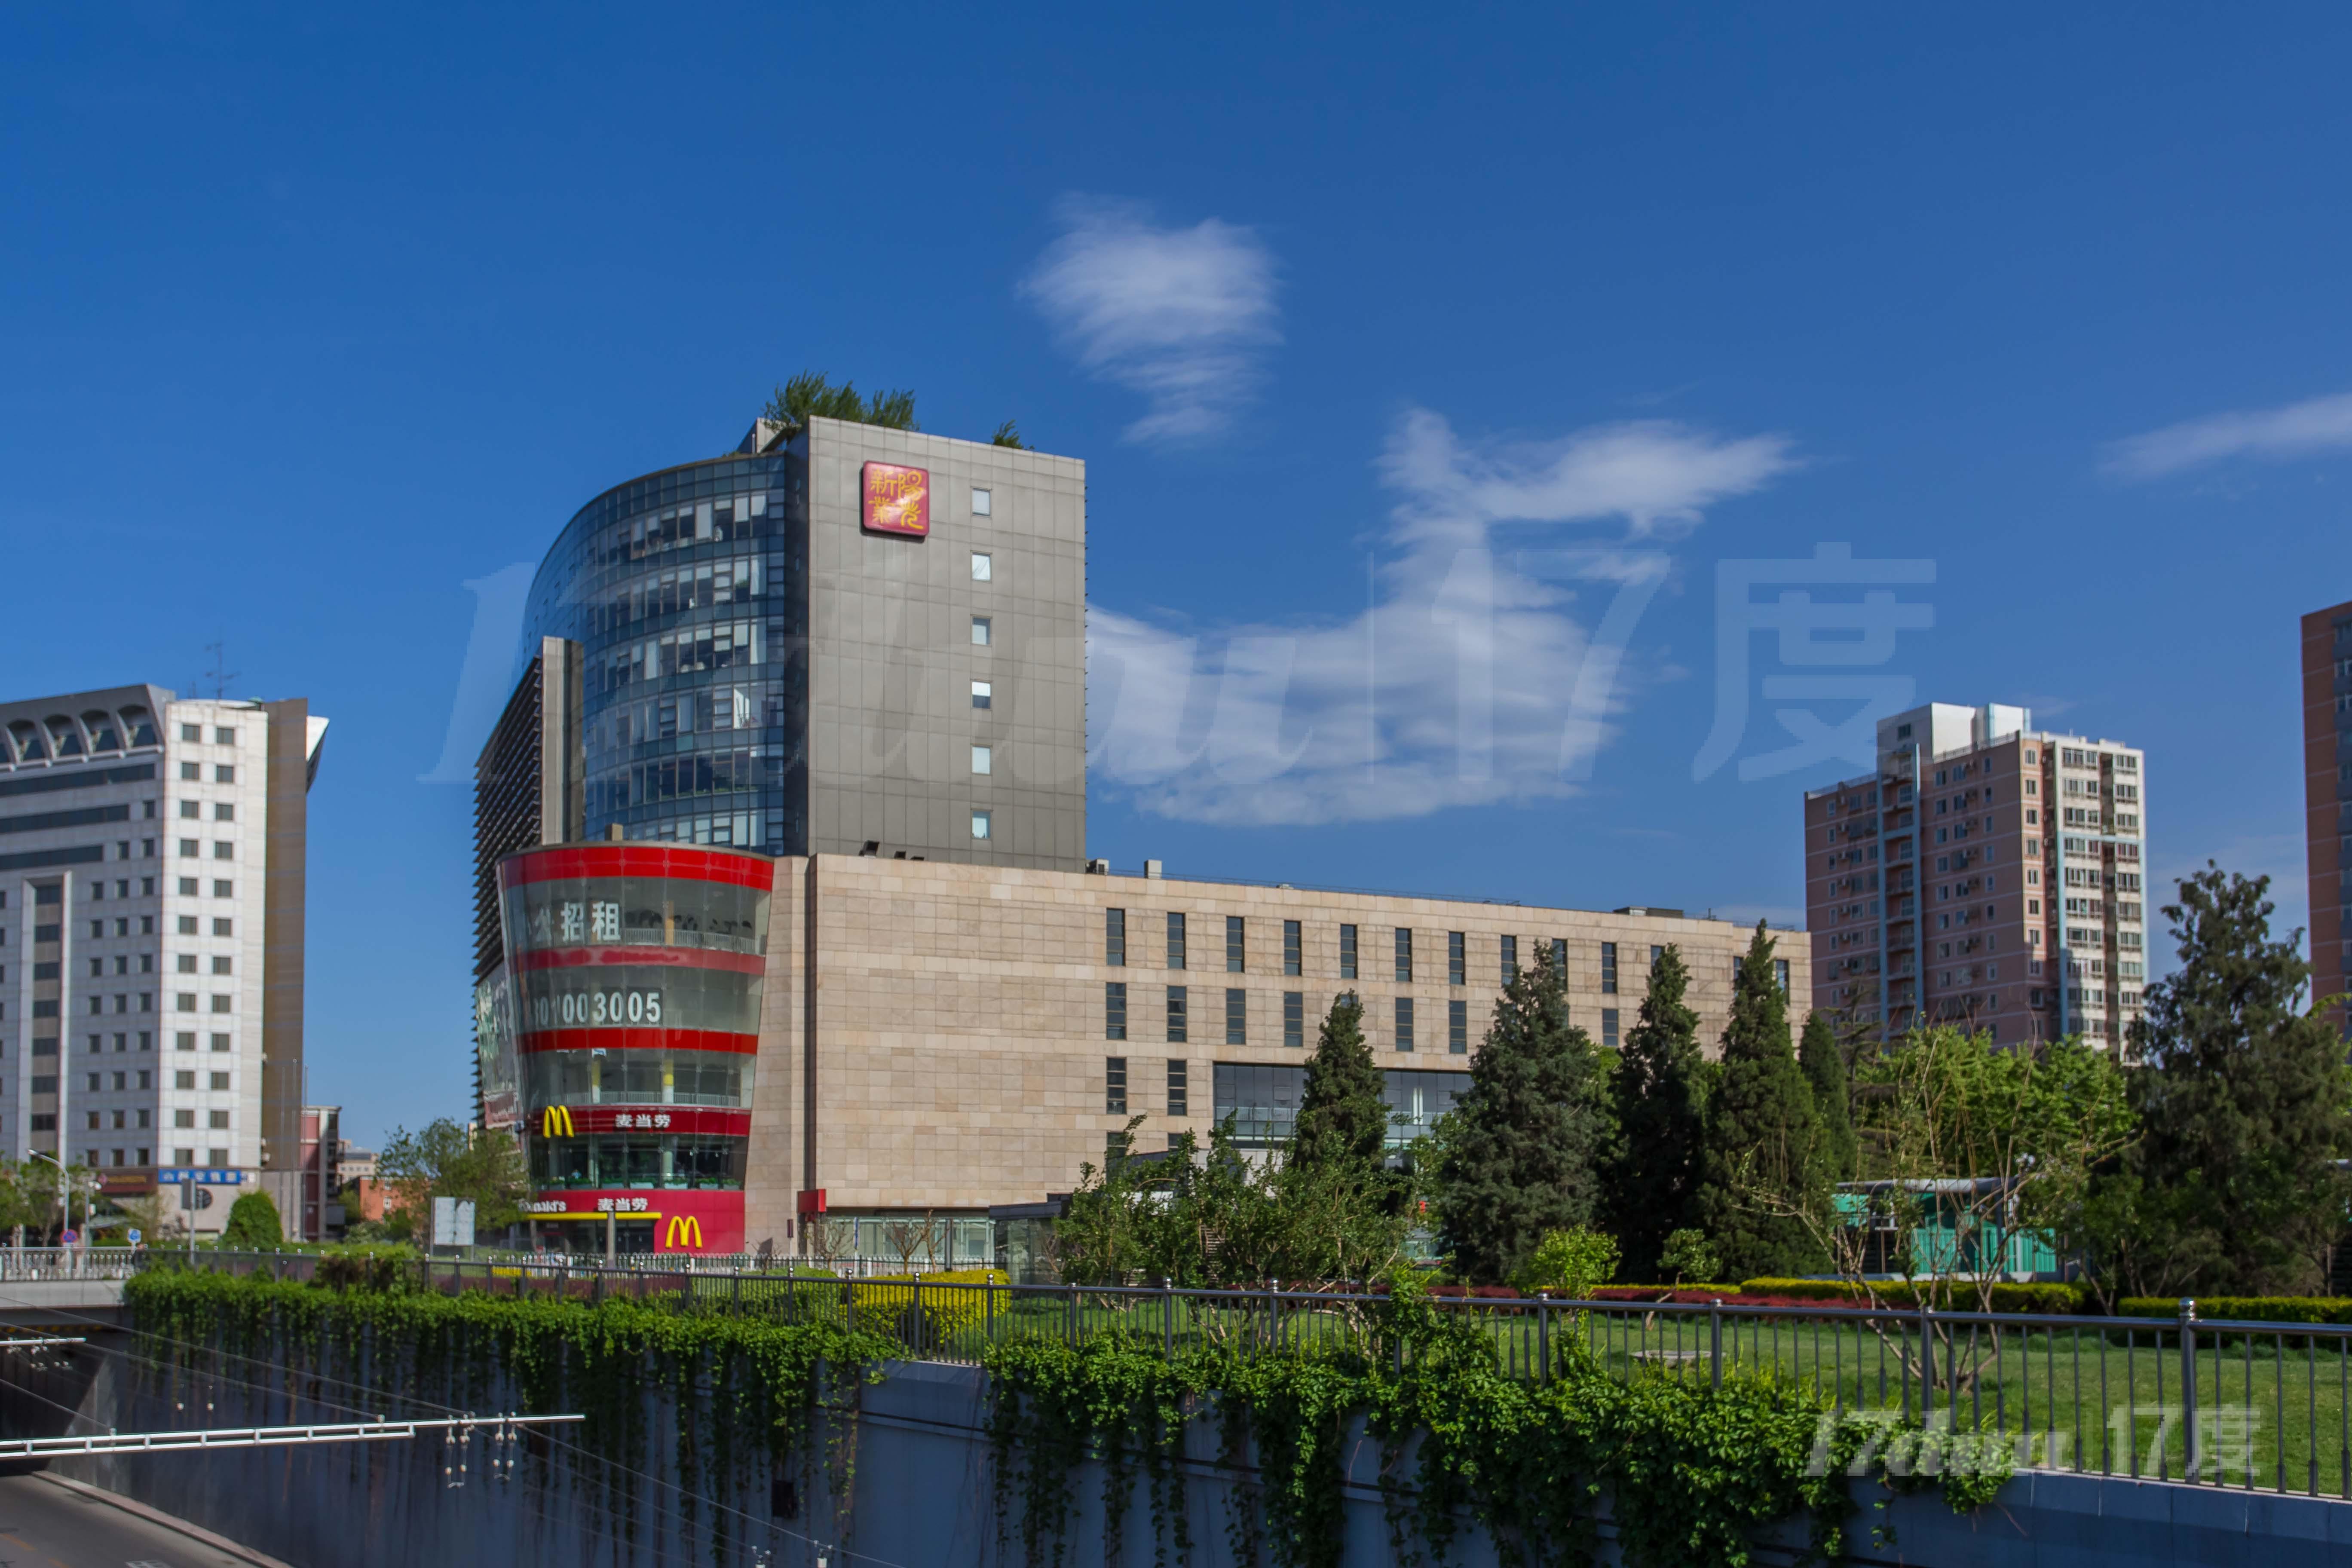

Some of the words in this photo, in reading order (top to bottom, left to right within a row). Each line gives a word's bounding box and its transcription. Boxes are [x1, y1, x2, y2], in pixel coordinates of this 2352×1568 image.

[615, 1114, 671, 1128] 麦当劳
[597, 1197, 648, 1212] 麦当劳
